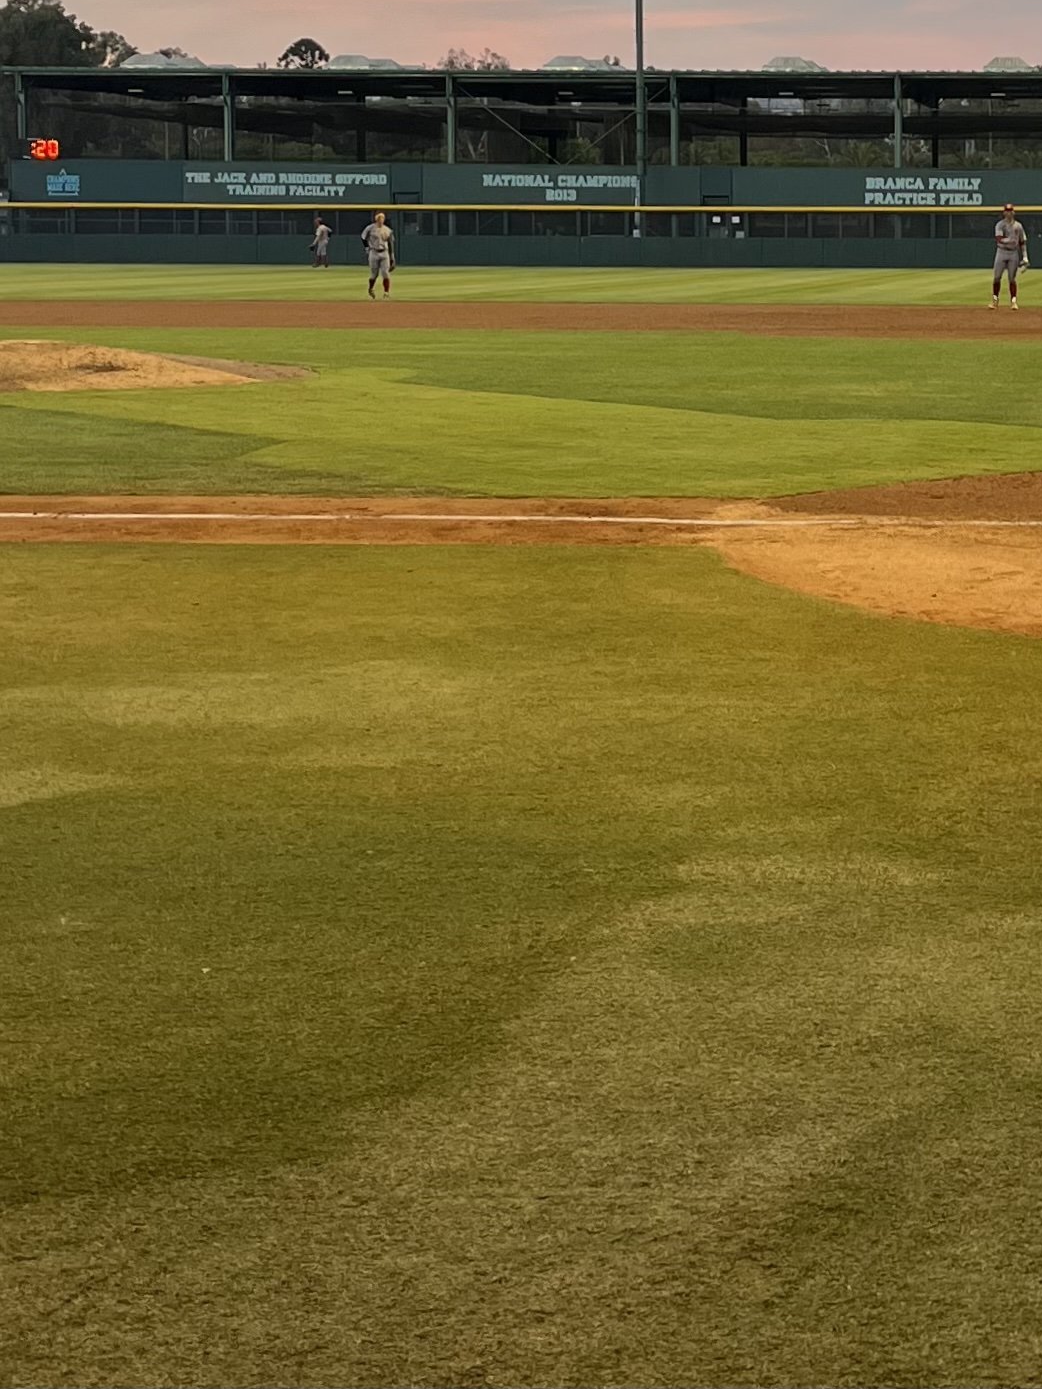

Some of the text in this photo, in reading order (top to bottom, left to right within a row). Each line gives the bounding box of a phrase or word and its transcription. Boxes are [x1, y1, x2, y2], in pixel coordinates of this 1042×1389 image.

[185, 172, 210, 183] THE
[214, 172, 246, 183] JACK
[250, 172, 275, 184] AND
[335, 174, 387, 185] GIFFORD
[483, 174, 638, 187] NATIONAL CHAMPIONS
[866, 177, 981, 190] BRANCA FAMILY
[227, 185, 346, 196] TRAINING FACILITY
[545, 188, 576, 201] 2013
[864, 192, 983, 205] PRACTICE FIELD
